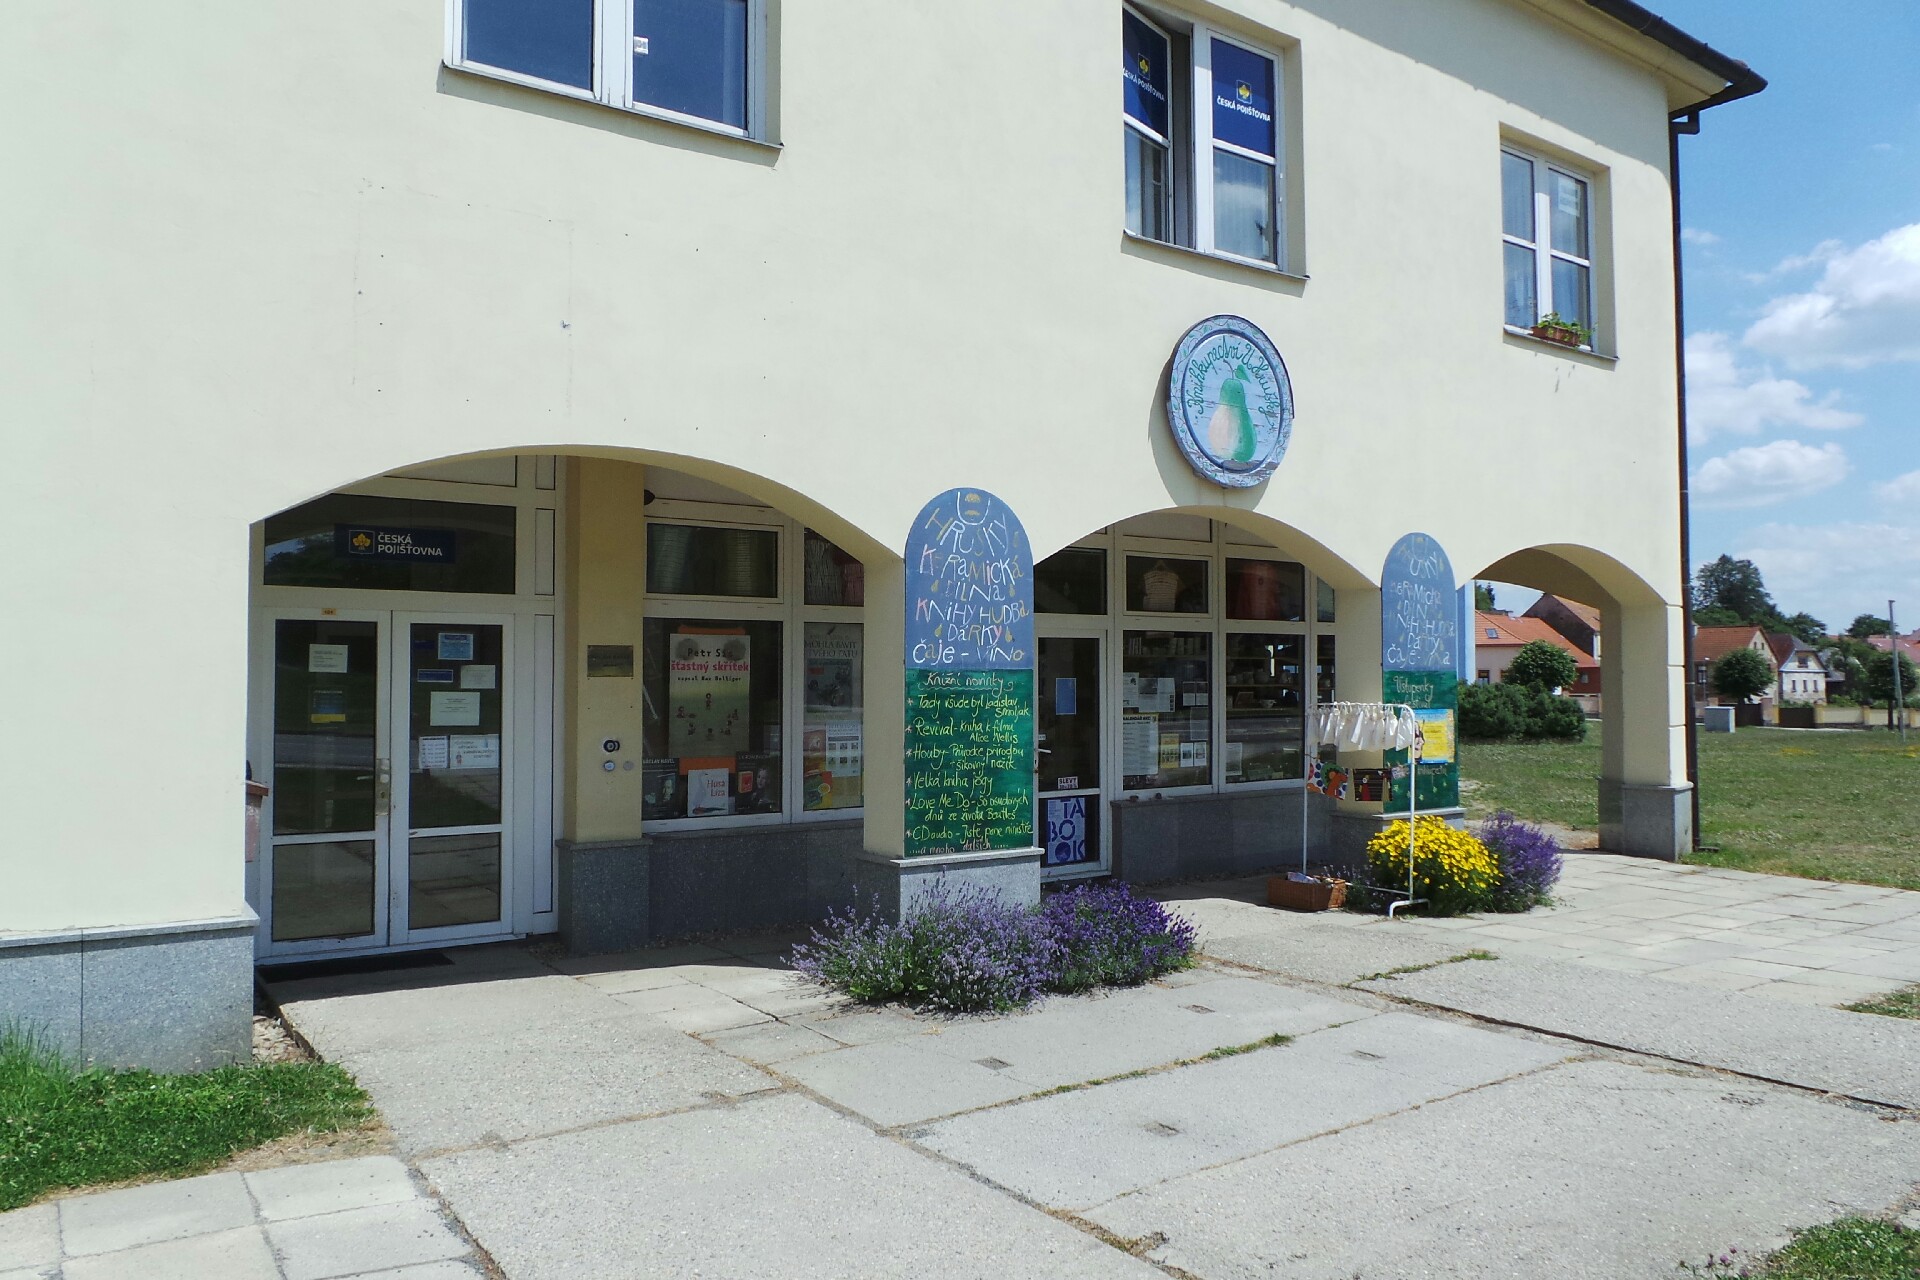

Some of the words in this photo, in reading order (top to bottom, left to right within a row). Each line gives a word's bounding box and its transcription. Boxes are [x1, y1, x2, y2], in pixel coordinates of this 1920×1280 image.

[1216, 95, 1236, 111] ČESKÁ
[1236, 103, 1271, 122] POJIŠŤOVNA
[1187, 335, 1242, 415] Knihkupectví
[956, 491, 991, 526] U
[377, 532, 413, 544] ČESKÁ
[377, 543, 443, 556] POJIŠŤOVNA
[687, 648, 712, 657] Petr
[712, 660, 749, 672] skřítek
[922, 672, 962, 687] Knižní
[965, 673, 1005, 698] novinky
[917, 693, 941, 719] Tady
[944, 694, 970, 709] všude
[970, 695, 985, 717] byl
[985, 696, 1019, 710] Ladislav
[994, 701, 1030, 722] Smoljak
[969, 733, 990, 743] Alice
[992, 732, 1019, 744] Nellis
[992, 720, 1015, 737] filmu
[707, 779, 725, 789] Husa
[913, 771, 941, 790] Velká
[943, 771, 969, 788] kniha
[909, 792, 936, 811] Love
[938, 794, 954, 808] Me
[1060, 797, 1086, 819] TA
[924, 808, 945, 822] dnů
[947, 812, 958, 821] ze
[960, 808, 985, 822] života
[986, 807, 1017, 821] Beatles
[984, 827, 1003, 844] pane
[1004, 821, 1034, 835] ministře
